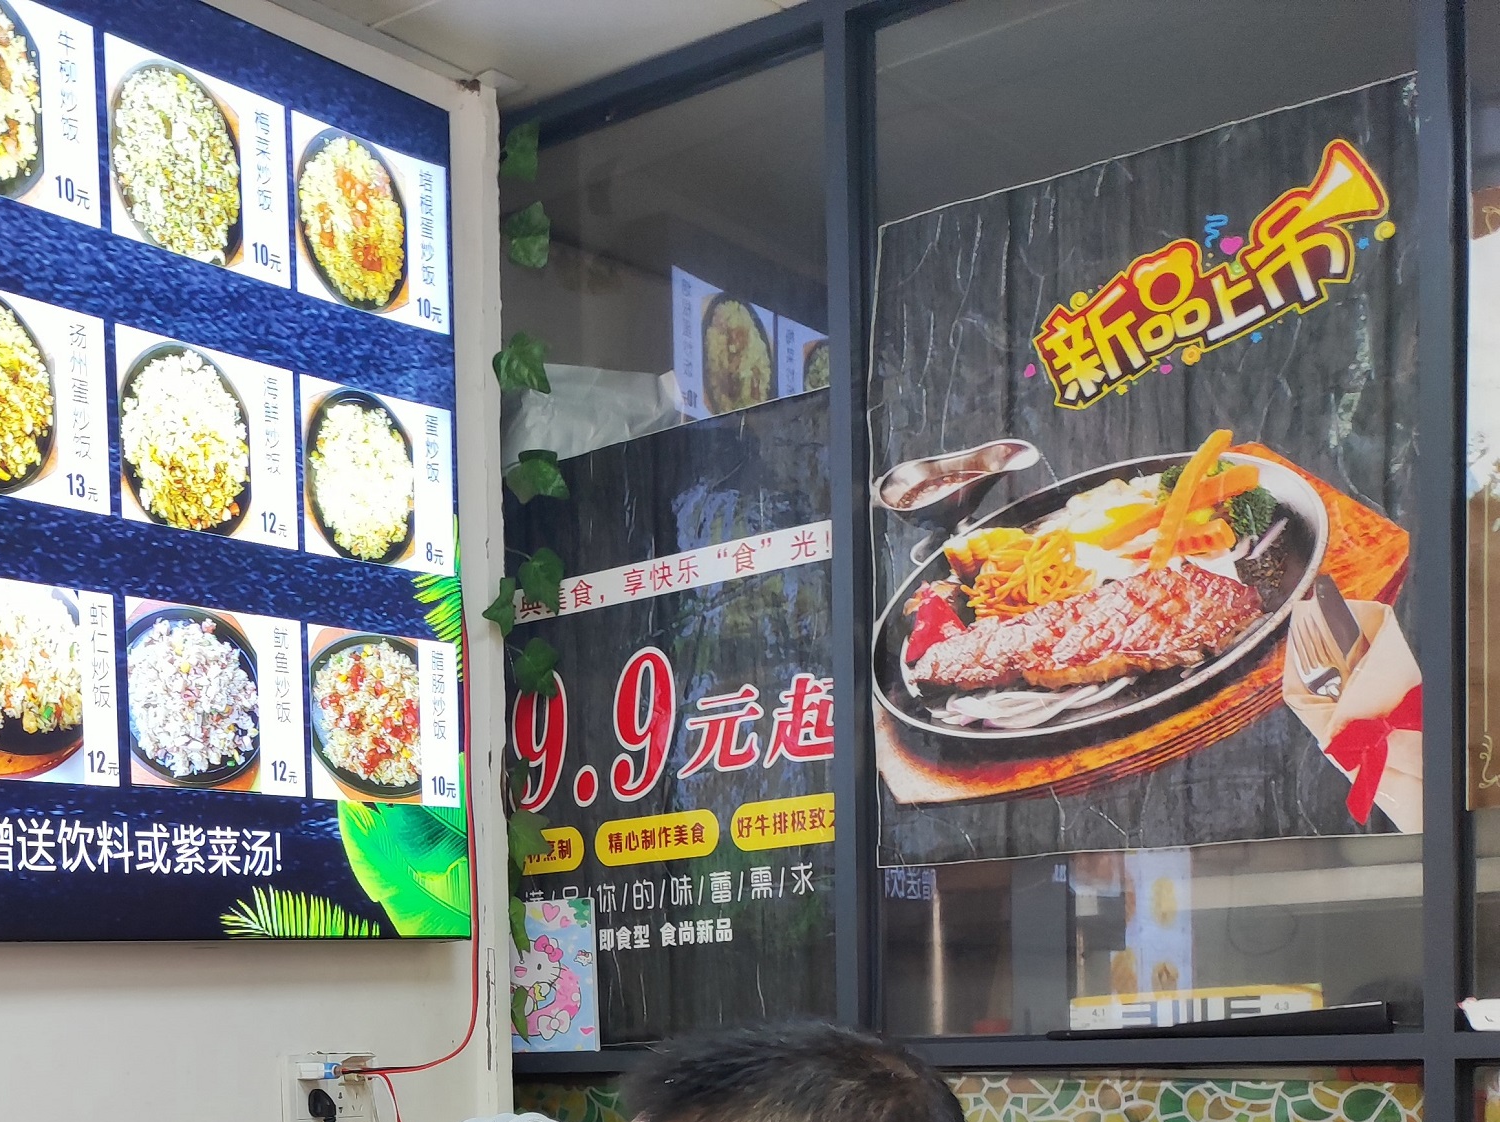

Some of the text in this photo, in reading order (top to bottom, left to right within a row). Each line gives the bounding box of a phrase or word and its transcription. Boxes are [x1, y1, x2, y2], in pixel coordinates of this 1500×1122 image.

[55, 174, 91, 210] 10元
[251, 241, 282, 273] 10元
[1037, 141, 1389, 408] 新品上市
[416, 296, 443, 324] 10元
[66, 472, 99, 502] 13元
[261, 510, 288, 538] 12元
[426, 541, 444, 566] 8元
[89, 602, 112, 709] 虾仁炒饭
[273, 625, 292, 724] 鱿鱼炒饭
[431, 650, 447, 741] 腊肠炒饭
[87, 749, 120, 777] 12元
[271, 760, 298, 784] 12元
[431, 775, 457, 799] 10元
[607, 822, 706, 854] 精心制作美食
[660, 917, 733, 947] 食尚新品
